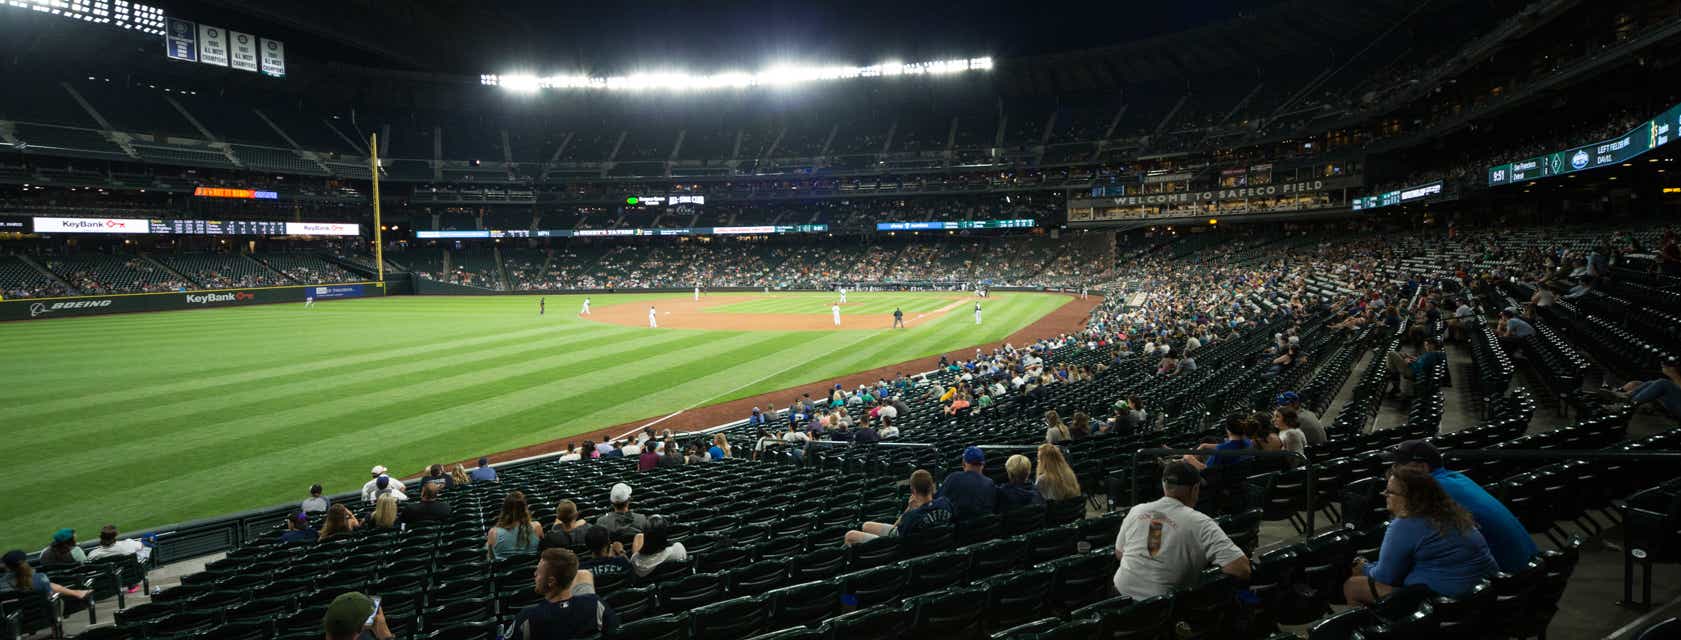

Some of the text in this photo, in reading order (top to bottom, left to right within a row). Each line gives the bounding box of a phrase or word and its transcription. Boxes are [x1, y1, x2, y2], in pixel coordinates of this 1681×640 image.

[1114, 180, 1323, 205] WELCOME TO SAFECO FIELD
[62, 220, 104, 229] KeyBank
[186, 292, 236, 304] KeyBank
[51, 300, 113, 310] BOEING
